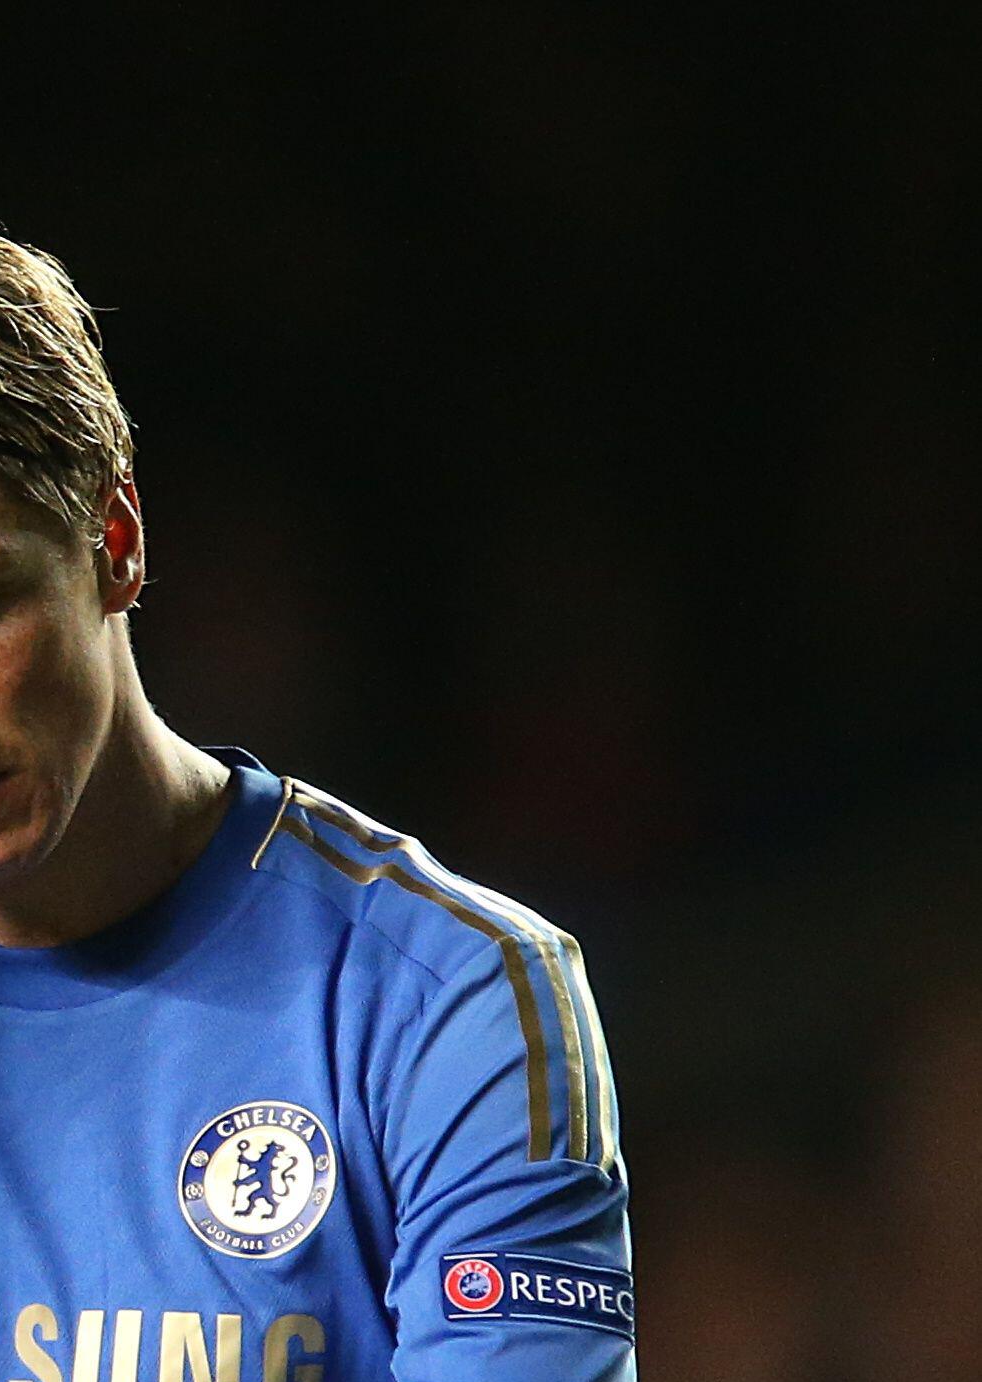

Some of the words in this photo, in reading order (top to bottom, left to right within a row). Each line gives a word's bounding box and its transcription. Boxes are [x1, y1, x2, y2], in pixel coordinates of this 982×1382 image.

[216, 1108, 317, 1141] CHELSEA
[200, 1218, 266, 1250] FOOTBALL
[271, 1221, 305, 1247] CLUB
[455, 1263, 491, 1277] UEFA
